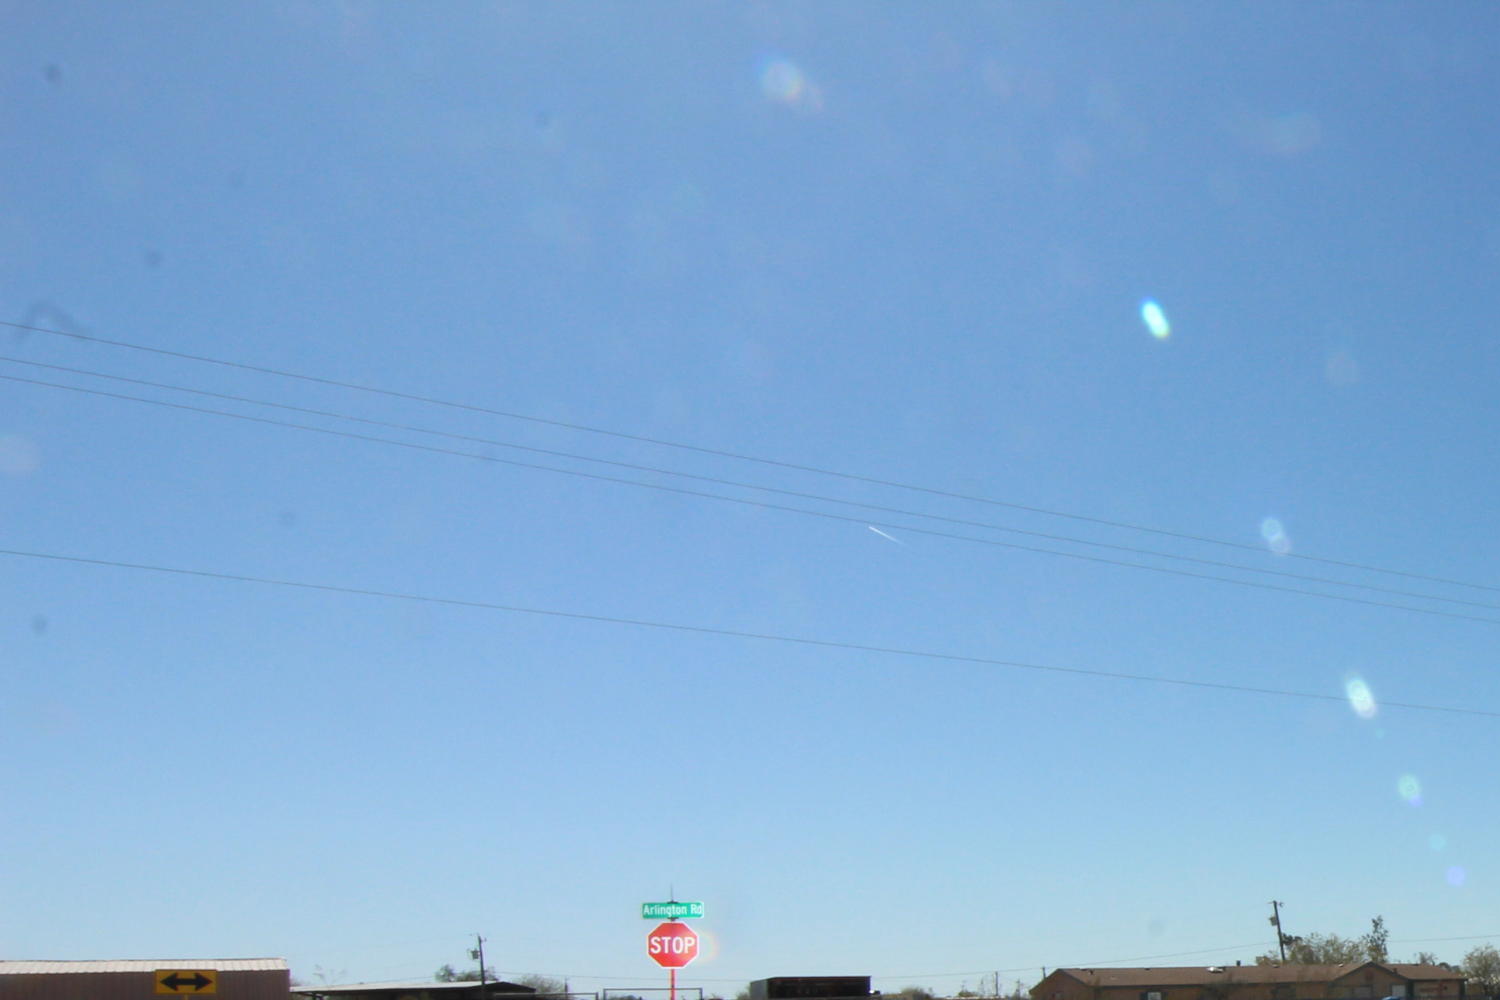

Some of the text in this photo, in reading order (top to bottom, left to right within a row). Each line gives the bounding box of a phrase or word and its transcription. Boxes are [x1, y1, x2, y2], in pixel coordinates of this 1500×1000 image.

[643, 904, 702, 917] Arlington Rd
[650, 936, 695, 954] STOP
